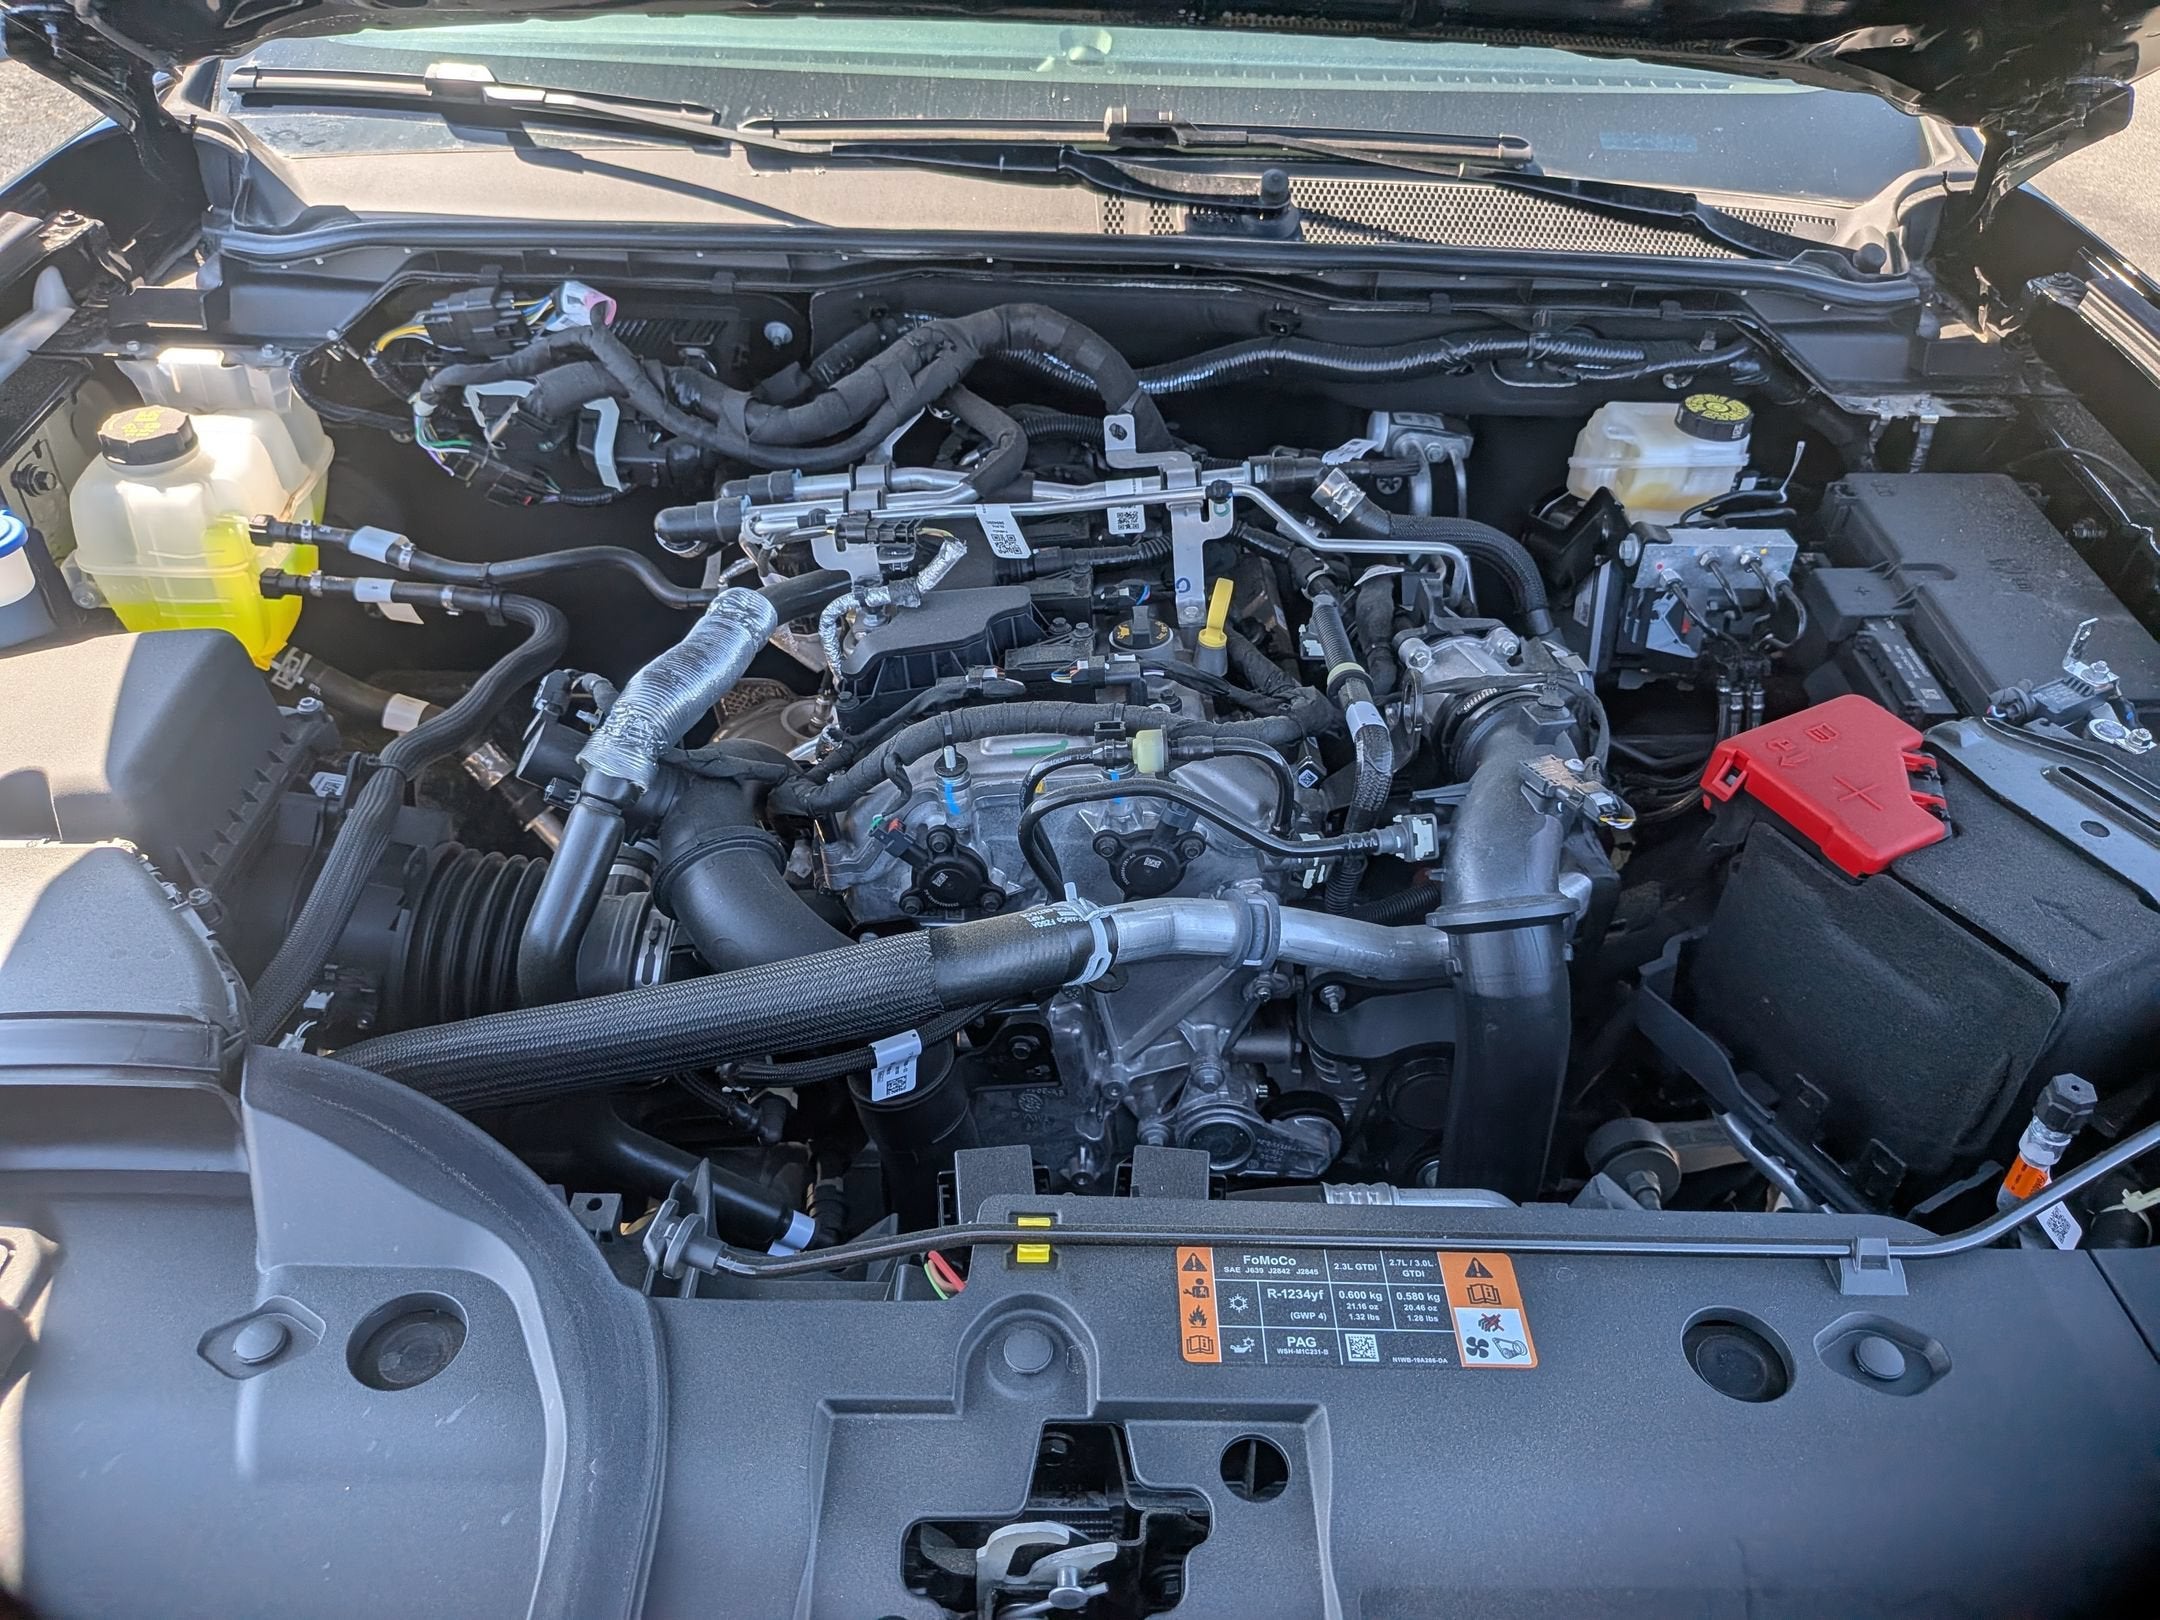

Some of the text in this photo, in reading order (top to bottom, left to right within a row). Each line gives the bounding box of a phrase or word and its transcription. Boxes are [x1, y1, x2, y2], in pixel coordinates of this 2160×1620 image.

[1243, 1255, 1297, 1266] FoMoCo
[1388, 1259, 1408, 1267] 2.7L
[1415, 1260, 1434, 1268] 3.0L
[1223, 1266, 1241, 1274] SAE
[1333, 1263, 1378, 1271] 2.3L GTDI
[1402, 1270, 1425, 1278] GTDI
[1267, 1288, 1325, 1302] R-1234yf
[1338, 1290, 1383, 1302] 0.600 kg
[1396, 1292, 1441, 1303] 0.580 kg
[1290, 1311, 1327, 1322] (GWP 4)
[1348, 1313, 1380, 1321] 1.32 lbs
[1286, 1336, 1317, 1348] PAG
